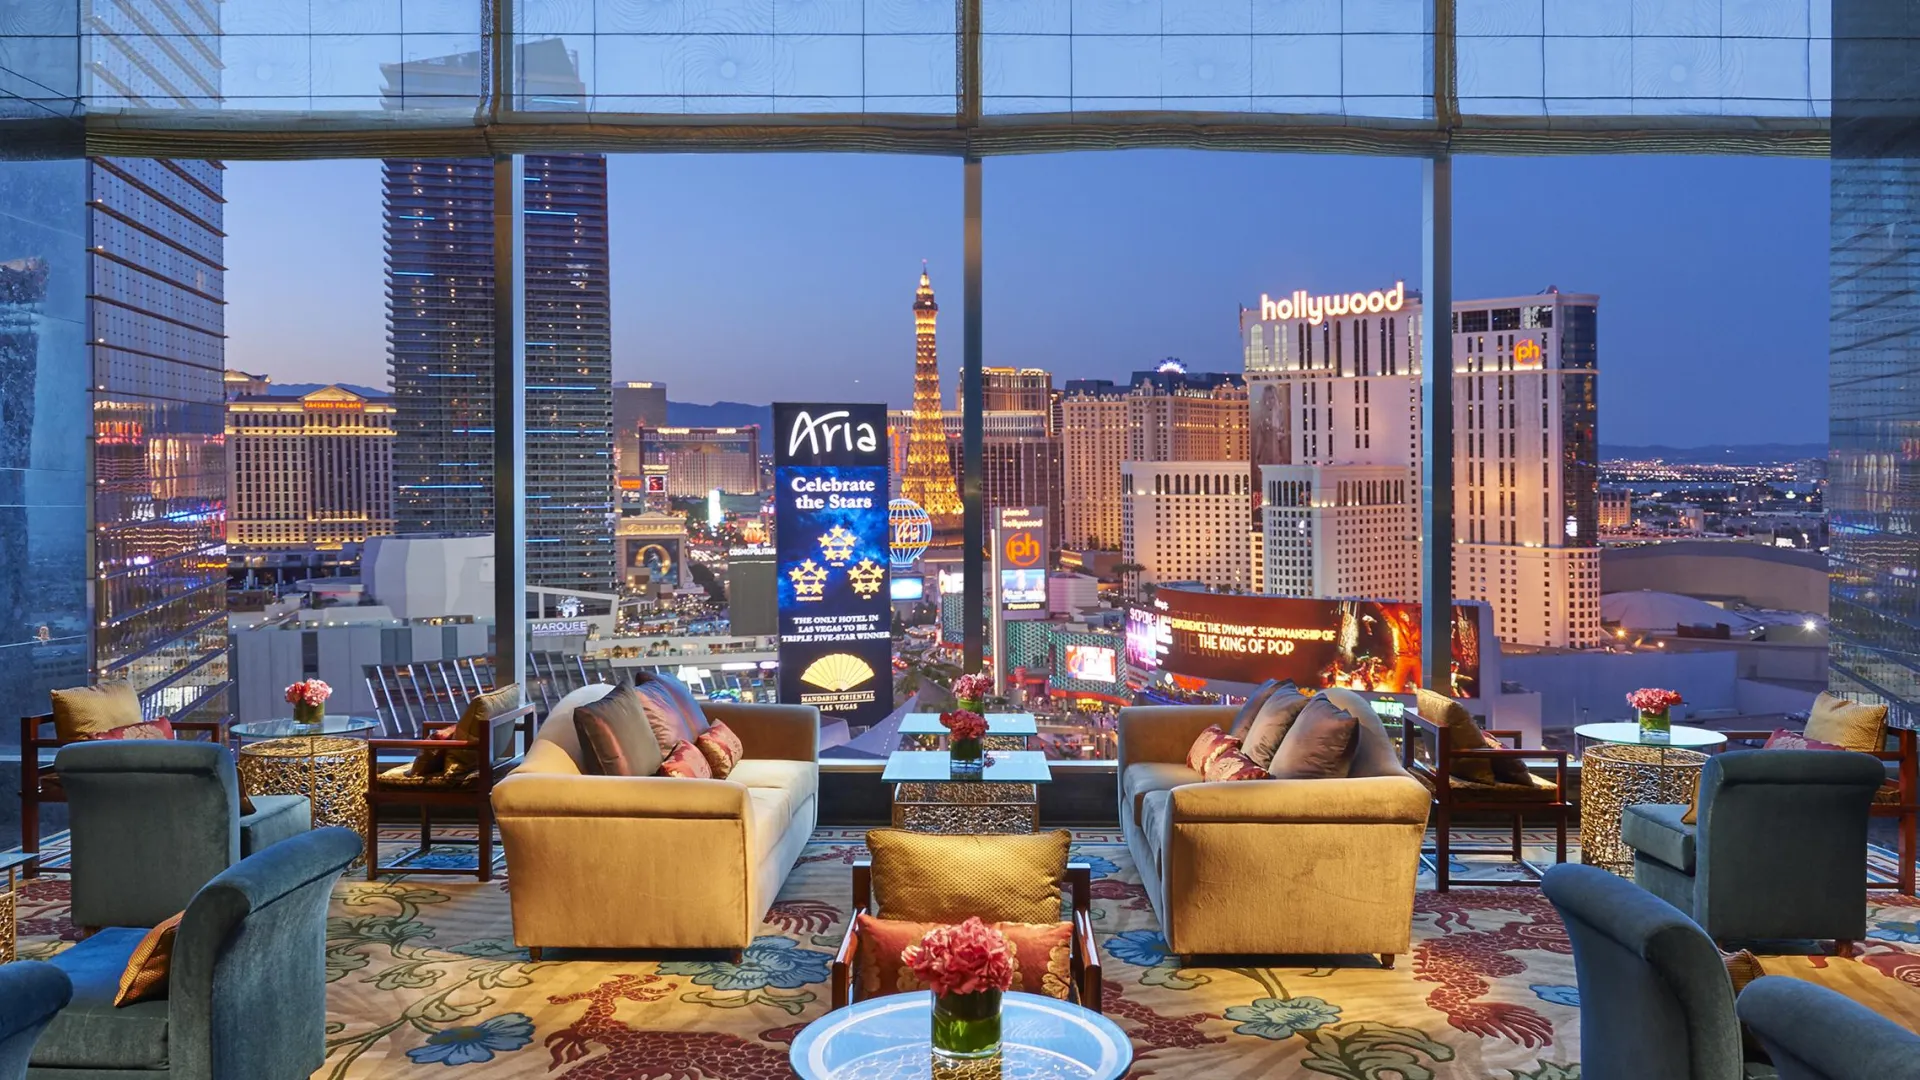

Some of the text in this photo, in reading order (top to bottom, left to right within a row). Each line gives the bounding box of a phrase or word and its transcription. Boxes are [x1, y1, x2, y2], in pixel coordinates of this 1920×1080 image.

[1260, 281, 1405, 325] hollywood
[1516, 340, 1540, 361] ph
[788, 411, 877, 456] Aria
[791, 477, 875, 493] Celebrate
[795, 494, 872, 509] the Stars
[1002, 508, 1029, 518] planet
[1002, 519, 1043, 529] hollywood
[729, 548, 776, 556] COSMOPOLITAN
[1010, 532, 1040, 561] ph
[793, 614, 879, 625] THE ONLY HOTEL IN
[532, 621, 587, 631] MARQUEE
[816, 625, 842, 633] VEGAS
[843, 624, 855, 632] TO
[1171, 618, 1207, 632] EXPERIENCE
[1207, 623, 1221, 634] THE
[1222, 624, 1257, 638] DYNAMIC
[1258, 627, 1322, 640] SHOWMANSHIP
[1322, 630, 1336, 641] OF
[781, 631, 890, 643] TRIPLE FIVE-STAR WINNER
[1197, 634, 1295, 656] THE KING OF POP
[801, 693, 875, 703] MANDARIN ORIENTAL
[835, 703, 858, 711] VEGAS
